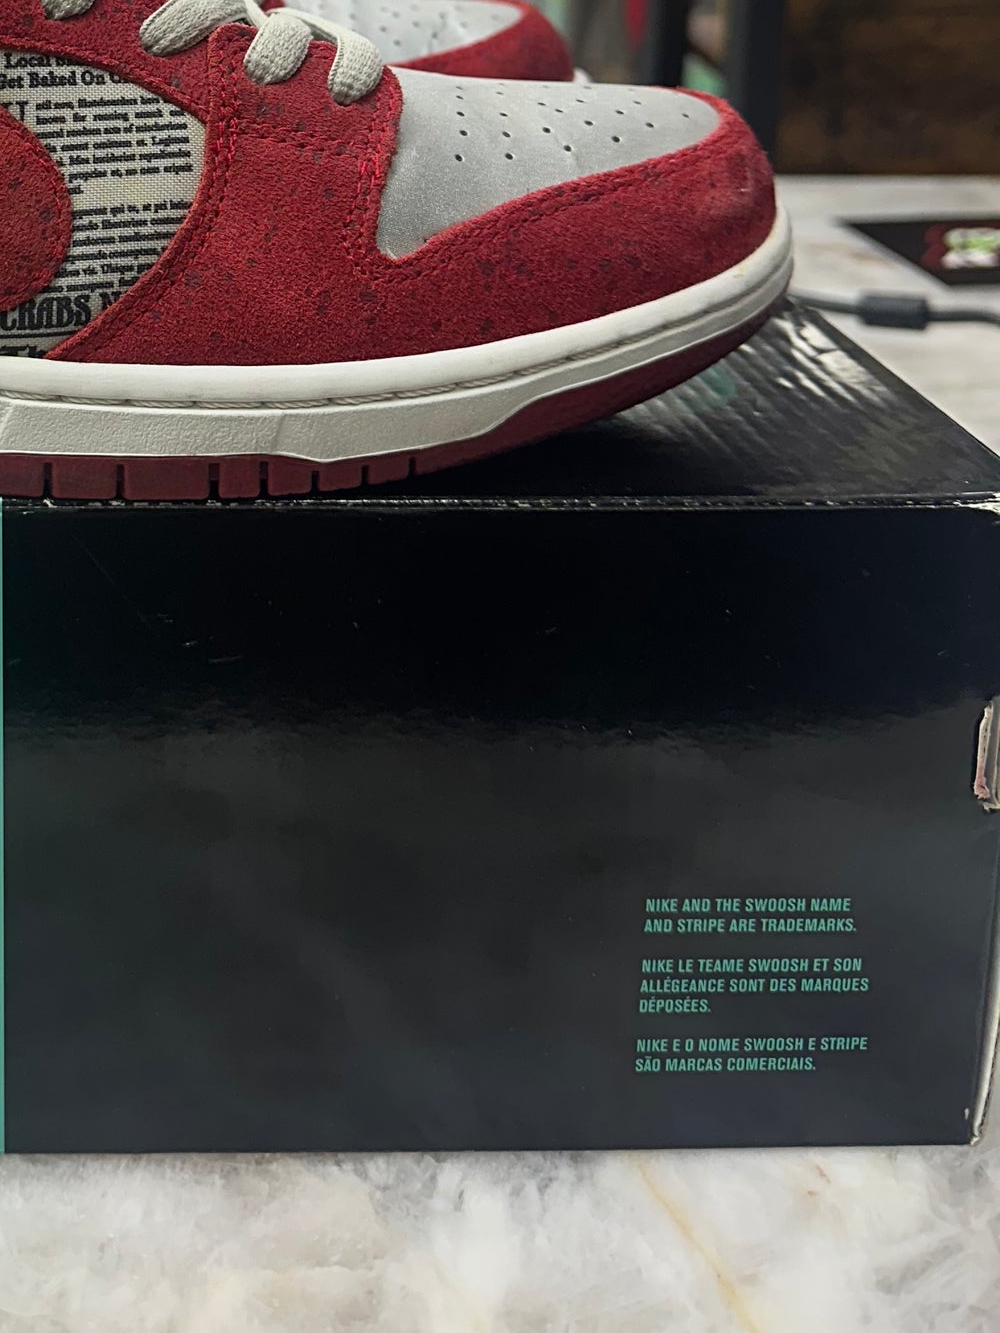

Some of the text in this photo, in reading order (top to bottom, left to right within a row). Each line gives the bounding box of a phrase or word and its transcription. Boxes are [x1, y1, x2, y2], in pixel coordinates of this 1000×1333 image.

[28, 71, 77, 88] Baked
[81, 70, 105, 85] On
[0, 295, 91, 331] CRABS
[645, 897, 852, 913] NIKE AND THE SWOOSH NAME
[643, 918, 857, 933] AND STRIPE ARE TRADEMARKS.
[641, 957, 862, 973] NIKE LE TEAME SWOOSH ET SON
[640, 976, 869, 993] ALLÉGEANCE SONT DES MARQUES
[639, 995, 711, 1014] DÉPOSÉES.
[636, 1036, 868, 1053] NIKE E O NOME SWOOSH E STRIPE
[635, 1055, 816, 1072] SÃO MARCAS COMERCIAIS.
